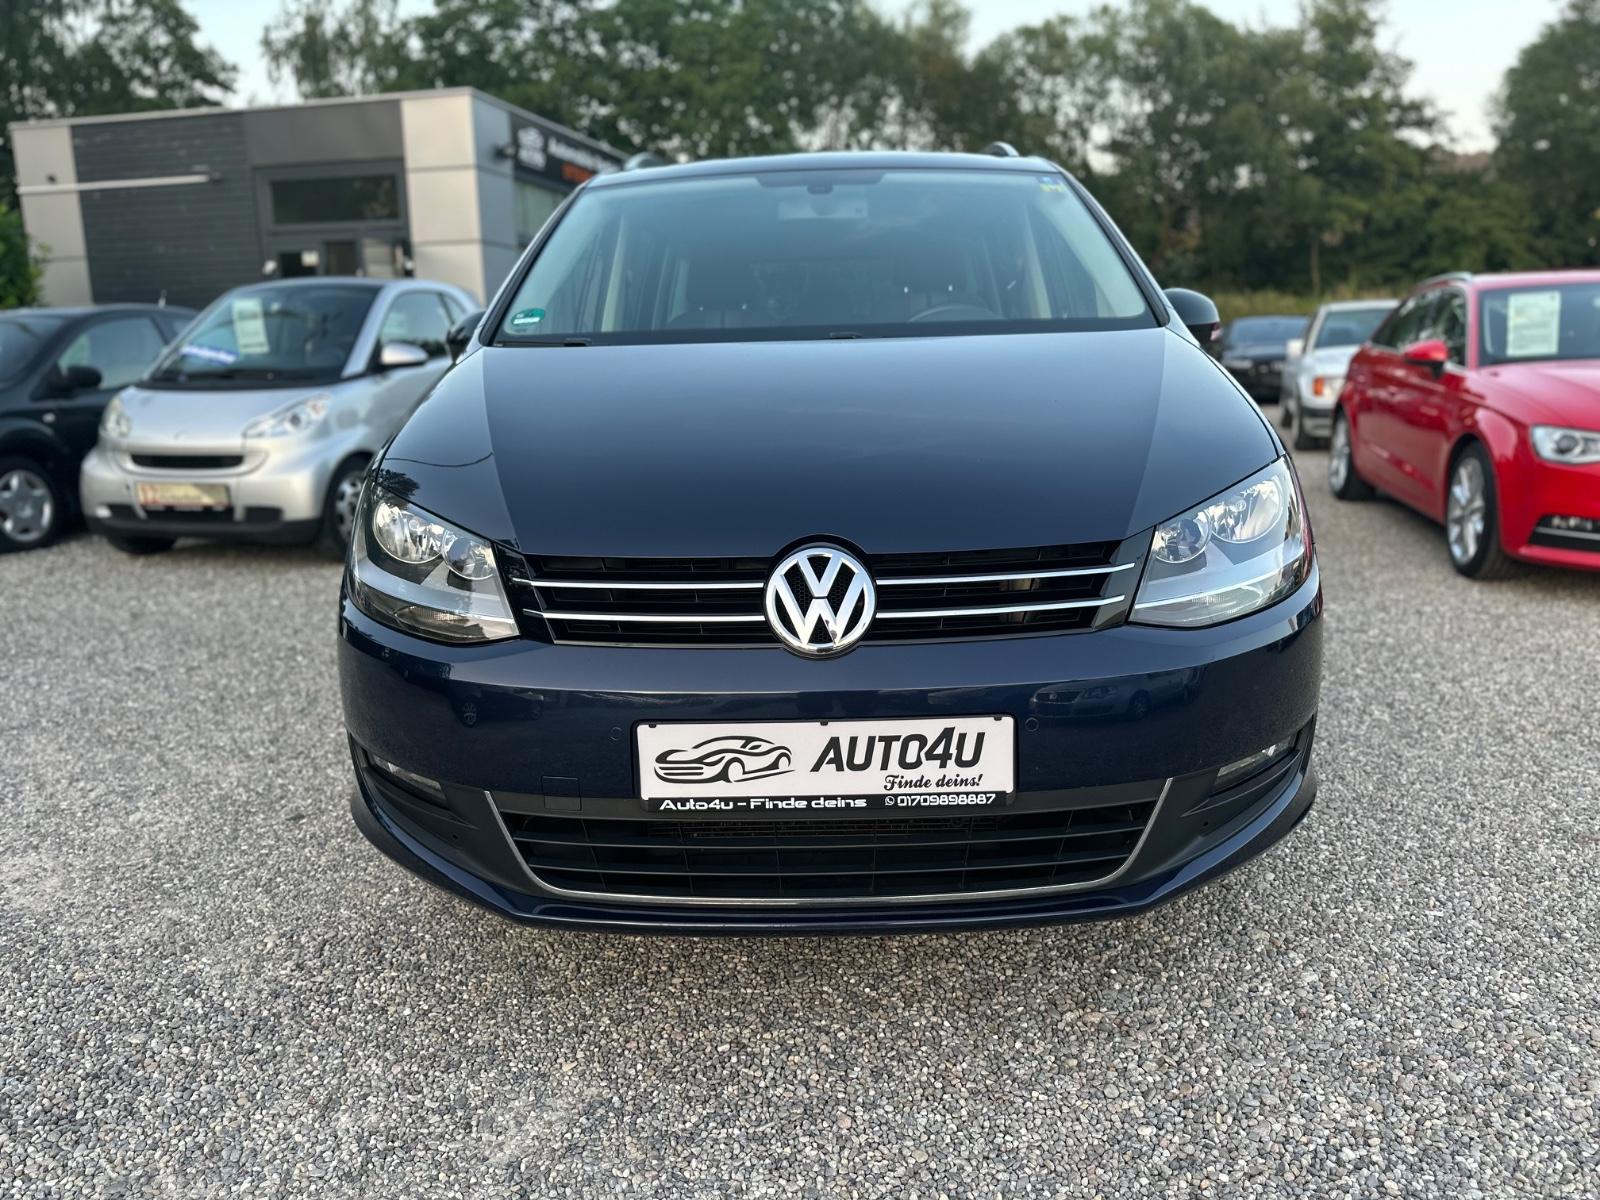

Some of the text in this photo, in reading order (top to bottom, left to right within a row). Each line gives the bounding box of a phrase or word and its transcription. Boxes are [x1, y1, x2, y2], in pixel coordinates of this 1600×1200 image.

[810, 726, 986, 772] AUTO4U
[883, 774, 983, 791] Finde deins!
[659, 798, 734, 811] Auto4u
[750, 797, 808, 809] Finde
[811, 797, 867, 808] deins
[897, 793, 996, 807] 01709898887
